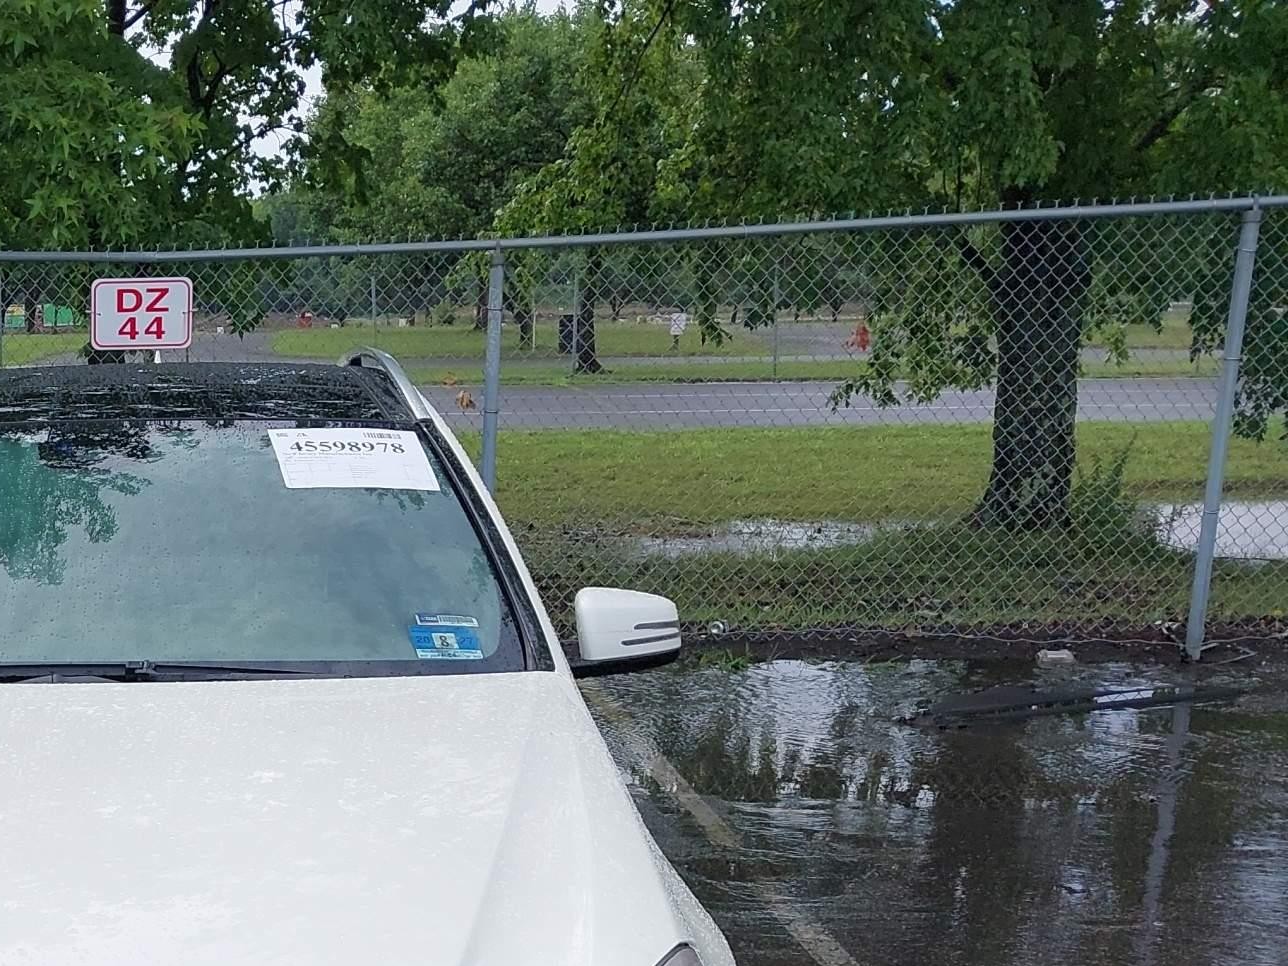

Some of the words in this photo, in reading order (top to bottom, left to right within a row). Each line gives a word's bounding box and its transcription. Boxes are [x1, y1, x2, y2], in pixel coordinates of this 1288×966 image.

[116, 287, 169, 313] DZ
[118, 316, 165, 340] 44
[289, 440, 405, 454] 45598978
[439, 635, 450, 647] 8
